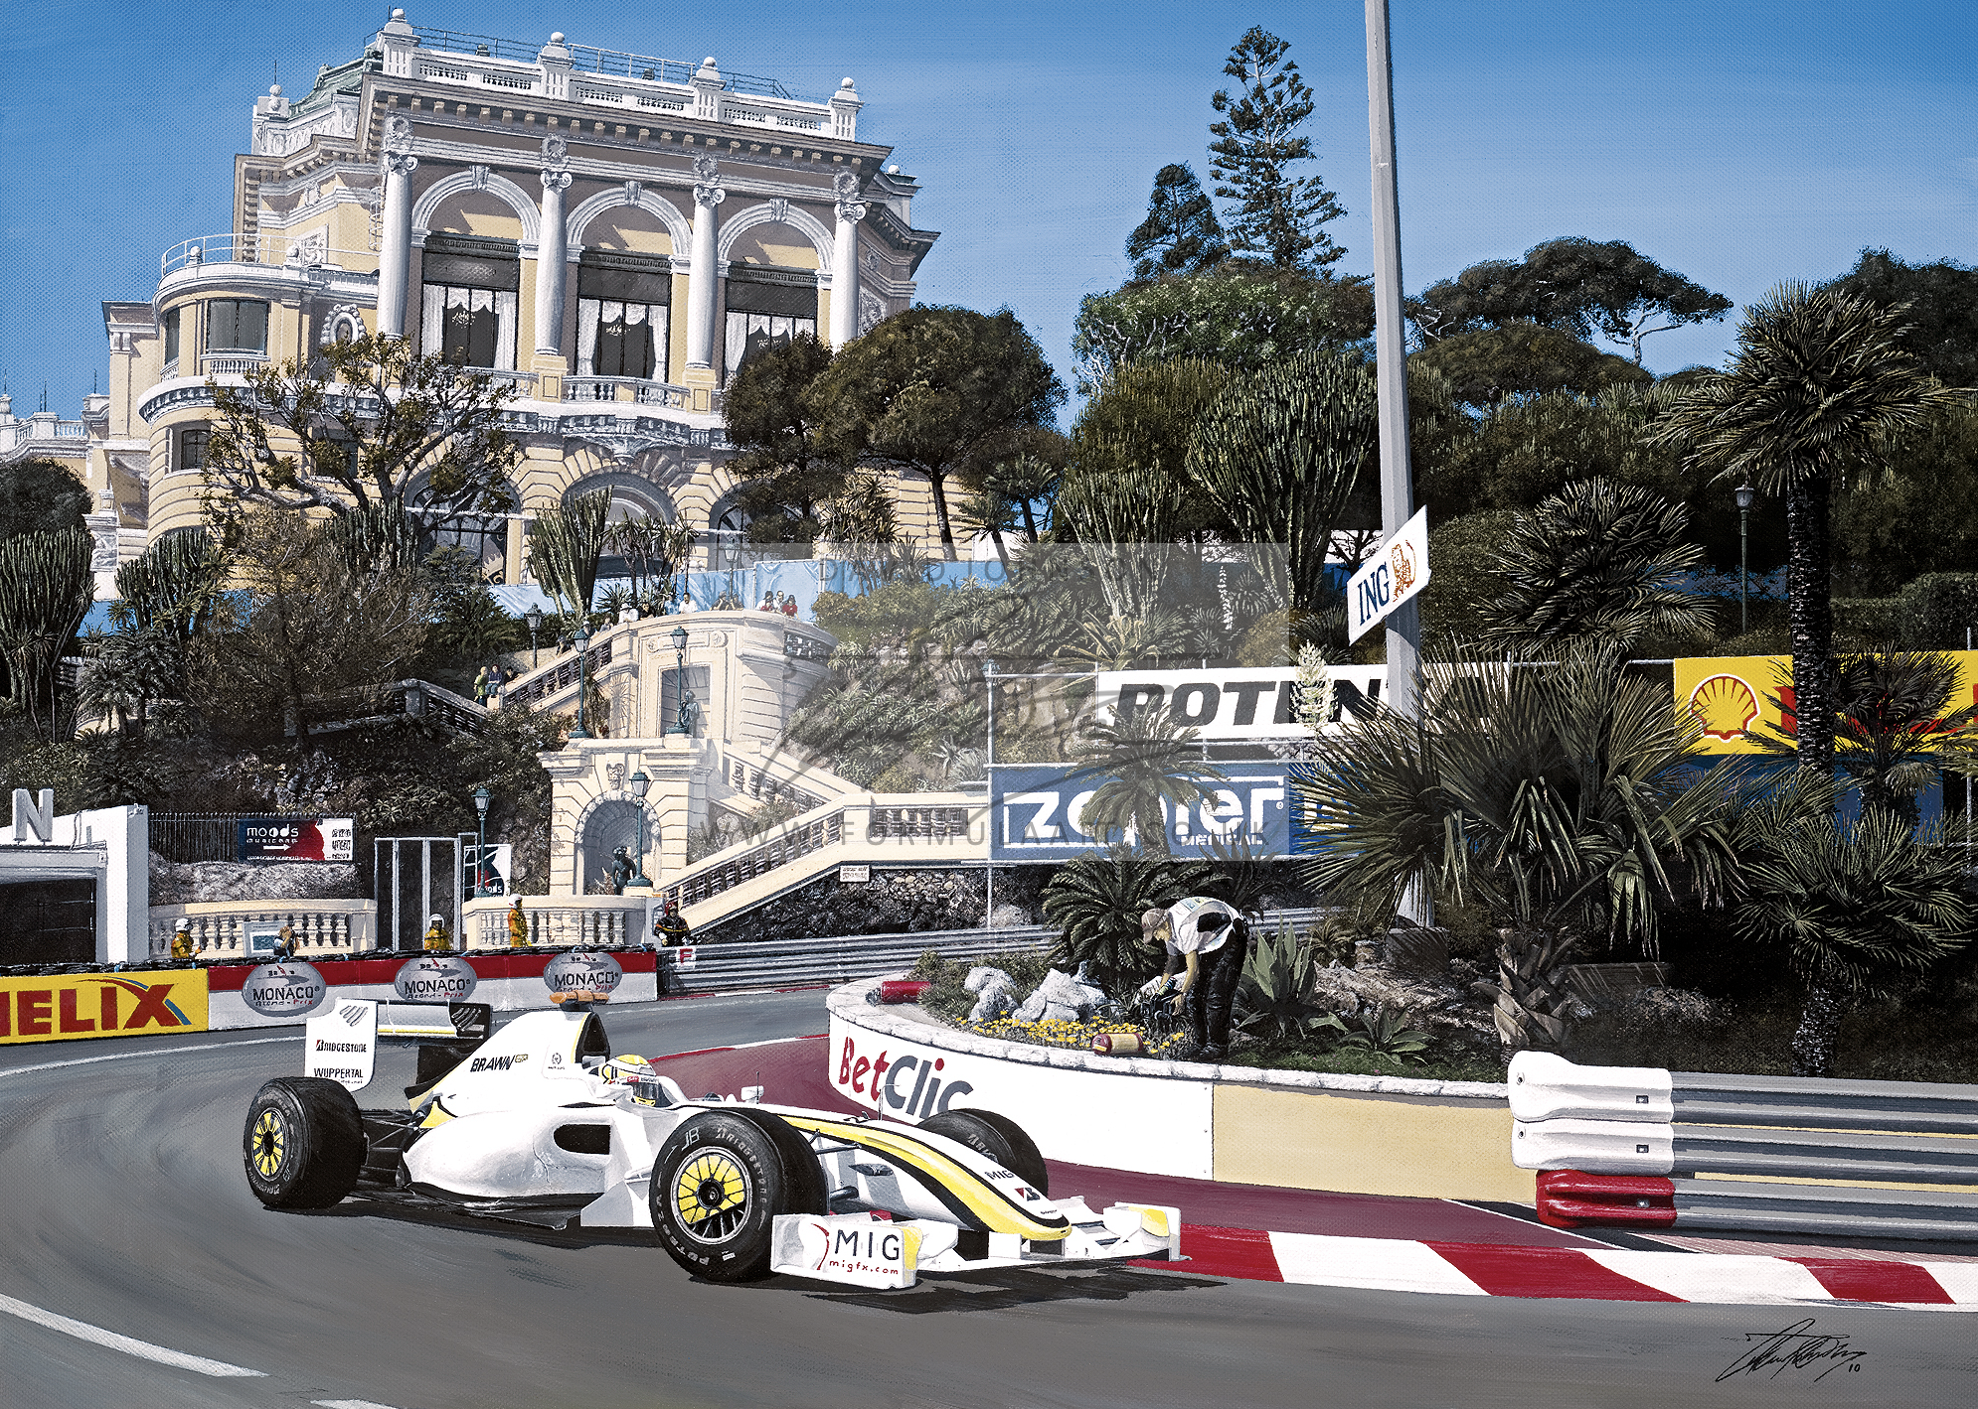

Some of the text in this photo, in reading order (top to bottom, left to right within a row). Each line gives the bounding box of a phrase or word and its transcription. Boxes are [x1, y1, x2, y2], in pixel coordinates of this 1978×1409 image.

[1358, 561, 1389, 626] ING
[12, 788, 54, 841] N
[246, 823, 299, 837] moods
[679, 948, 693, 964] F
[470, 1054, 516, 1073] BRAWN
[313, 1067, 364, 1079] WUPPERTAL
[834, 1229, 900, 1261] MIG
[829, 1259, 899, 1275] migfx.com
